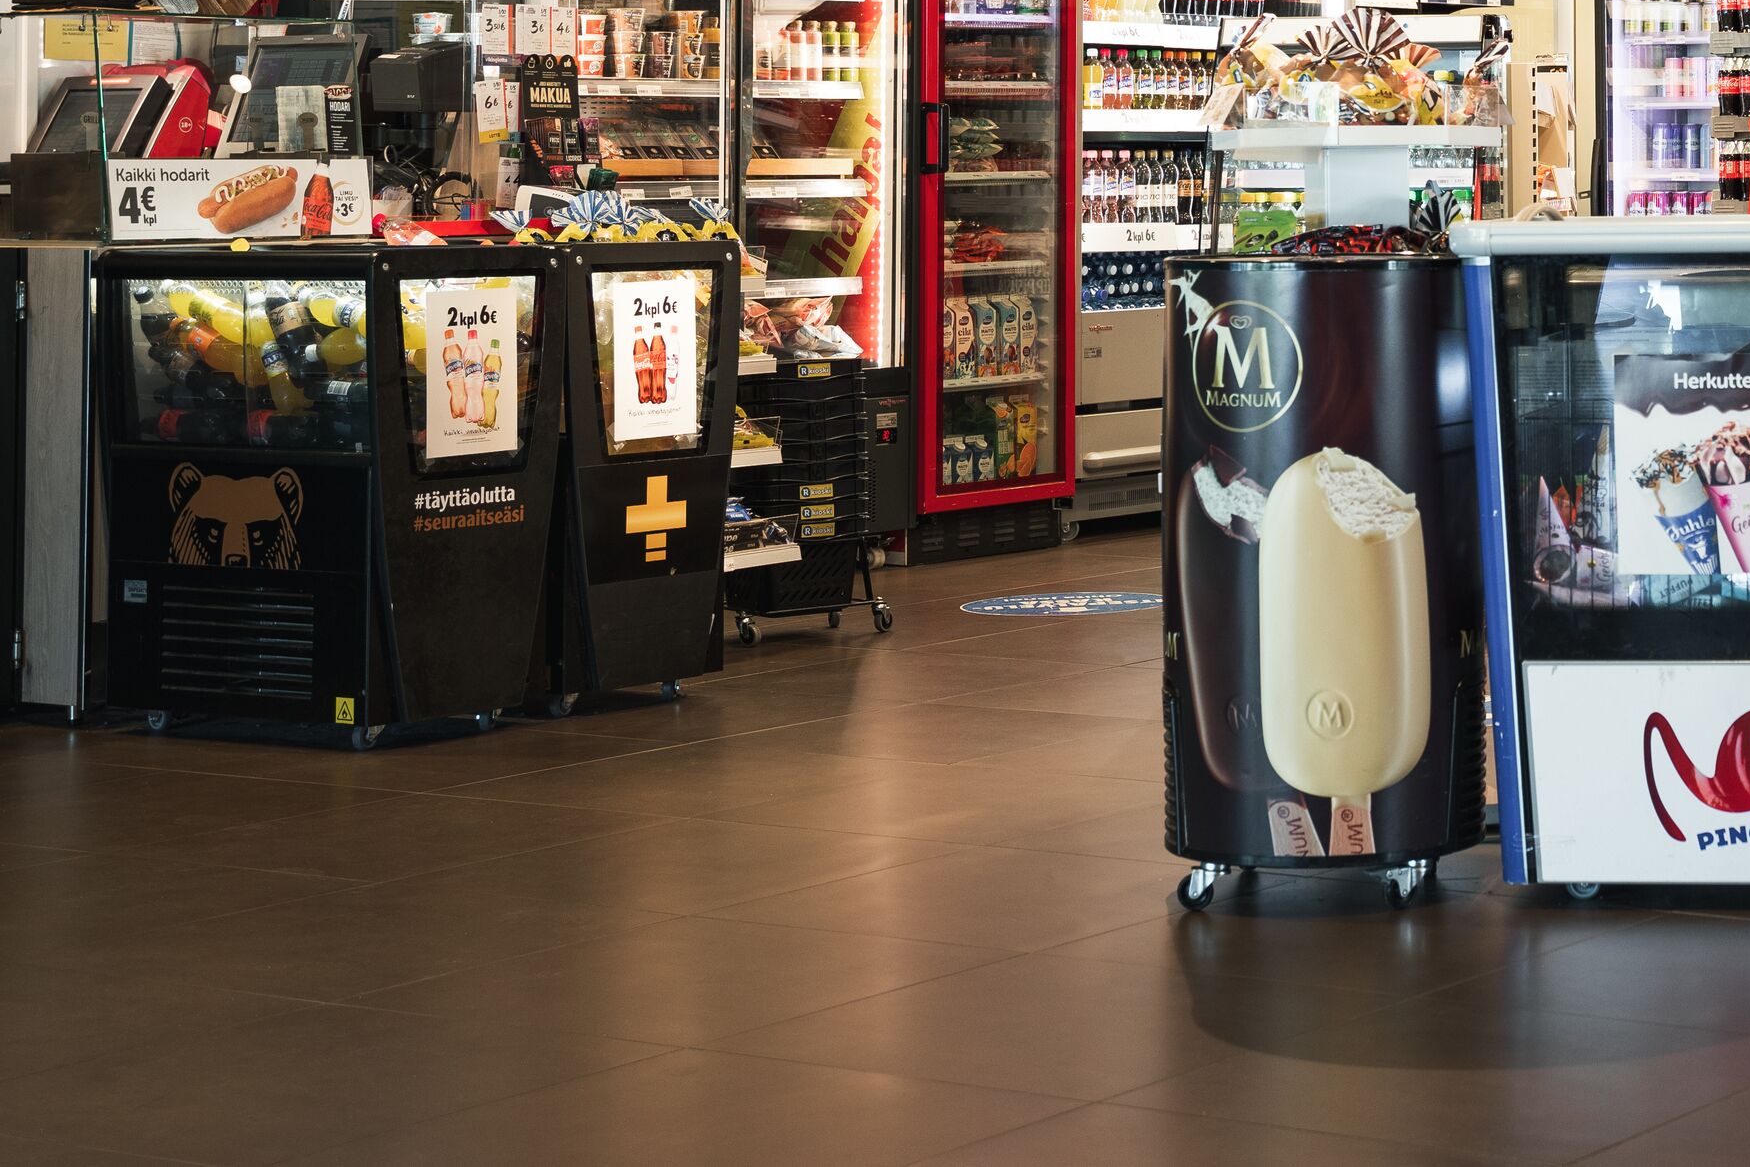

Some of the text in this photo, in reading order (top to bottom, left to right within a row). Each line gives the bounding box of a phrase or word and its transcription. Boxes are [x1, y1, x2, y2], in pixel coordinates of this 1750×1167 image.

[529, 86, 572, 104] MAKUA
[329, 100, 351, 112] HODARI
[115, 166, 210, 182] Kaikki hodarit
[118, 185, 157, 224] 4€
[143, 213, 157, 226] kpl
[447, 304, 498, 329] 2 kpl 6€
[633, 297, 644, 316] 2
[1211, 324, 1276, 390] M
[1205, 389, 1281, 409] MAGNUM
[414, 485, 516, 510] #täyttäolutta
[413, 504, 525, 532] #seuraaitseäsi
